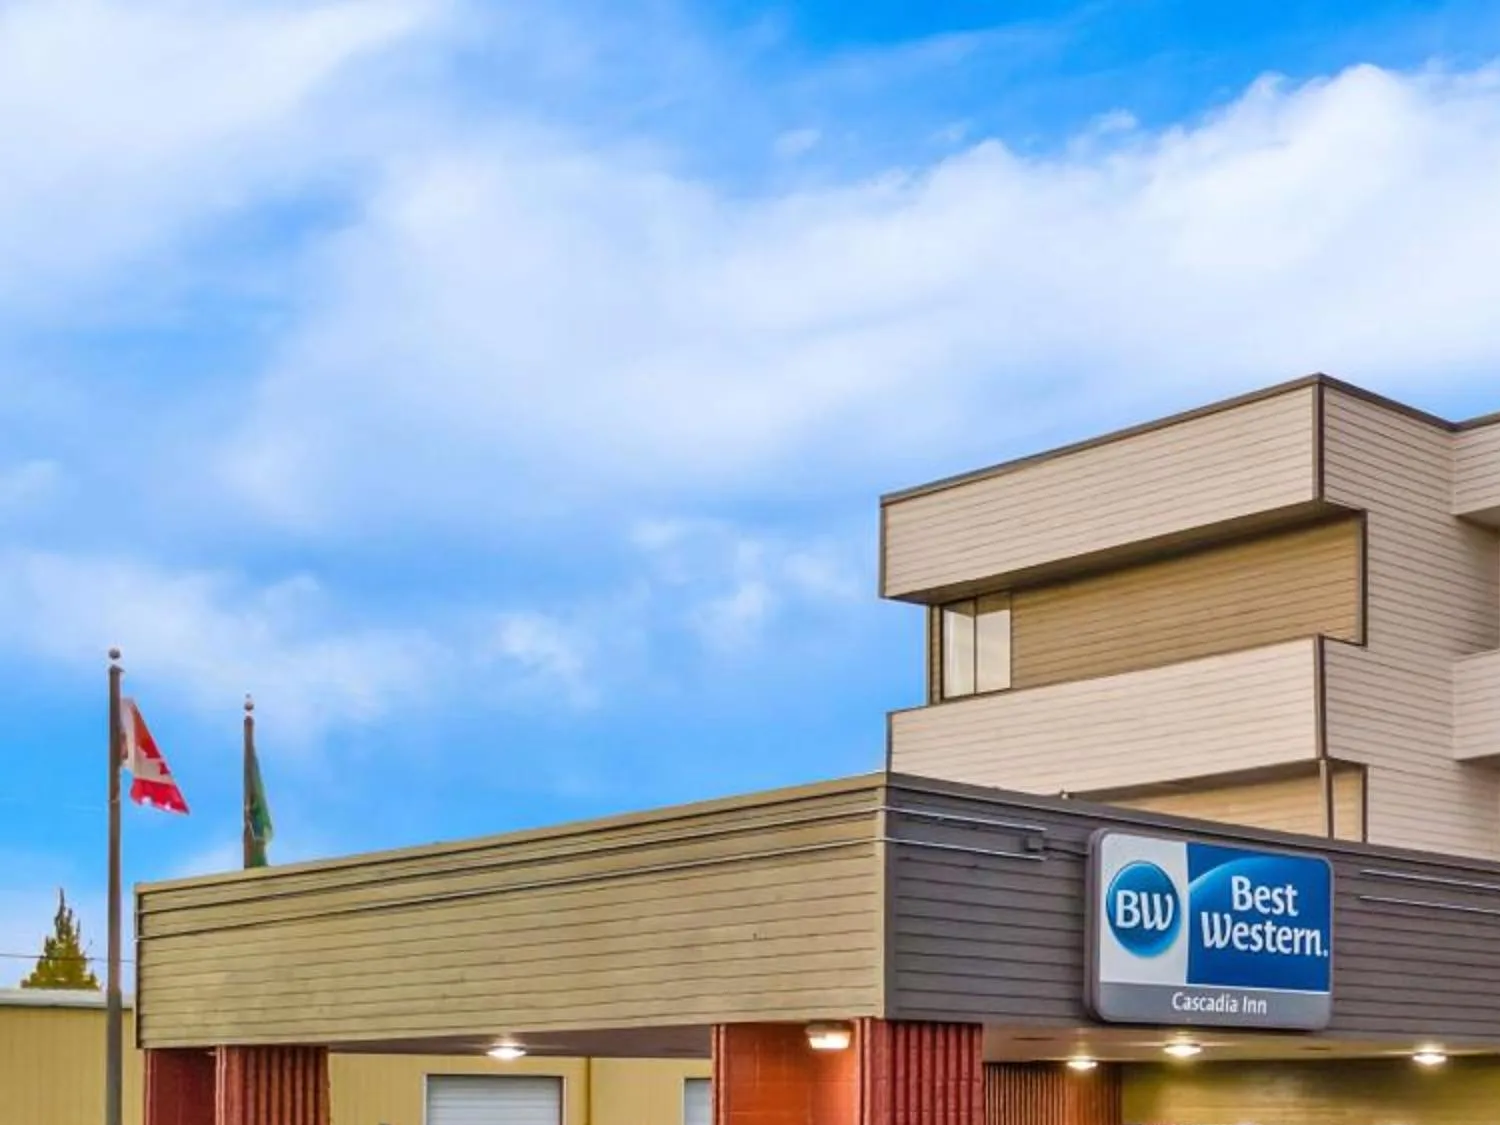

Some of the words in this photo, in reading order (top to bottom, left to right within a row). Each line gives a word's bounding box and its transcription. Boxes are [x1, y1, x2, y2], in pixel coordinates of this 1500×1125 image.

[1115, 889, 1175, 932] BW
[1231, 875, 1299, 918] Best
[1171, 991, 1238, 1014] Cascadia
[1242, 996, 1268, 1015] Inn
